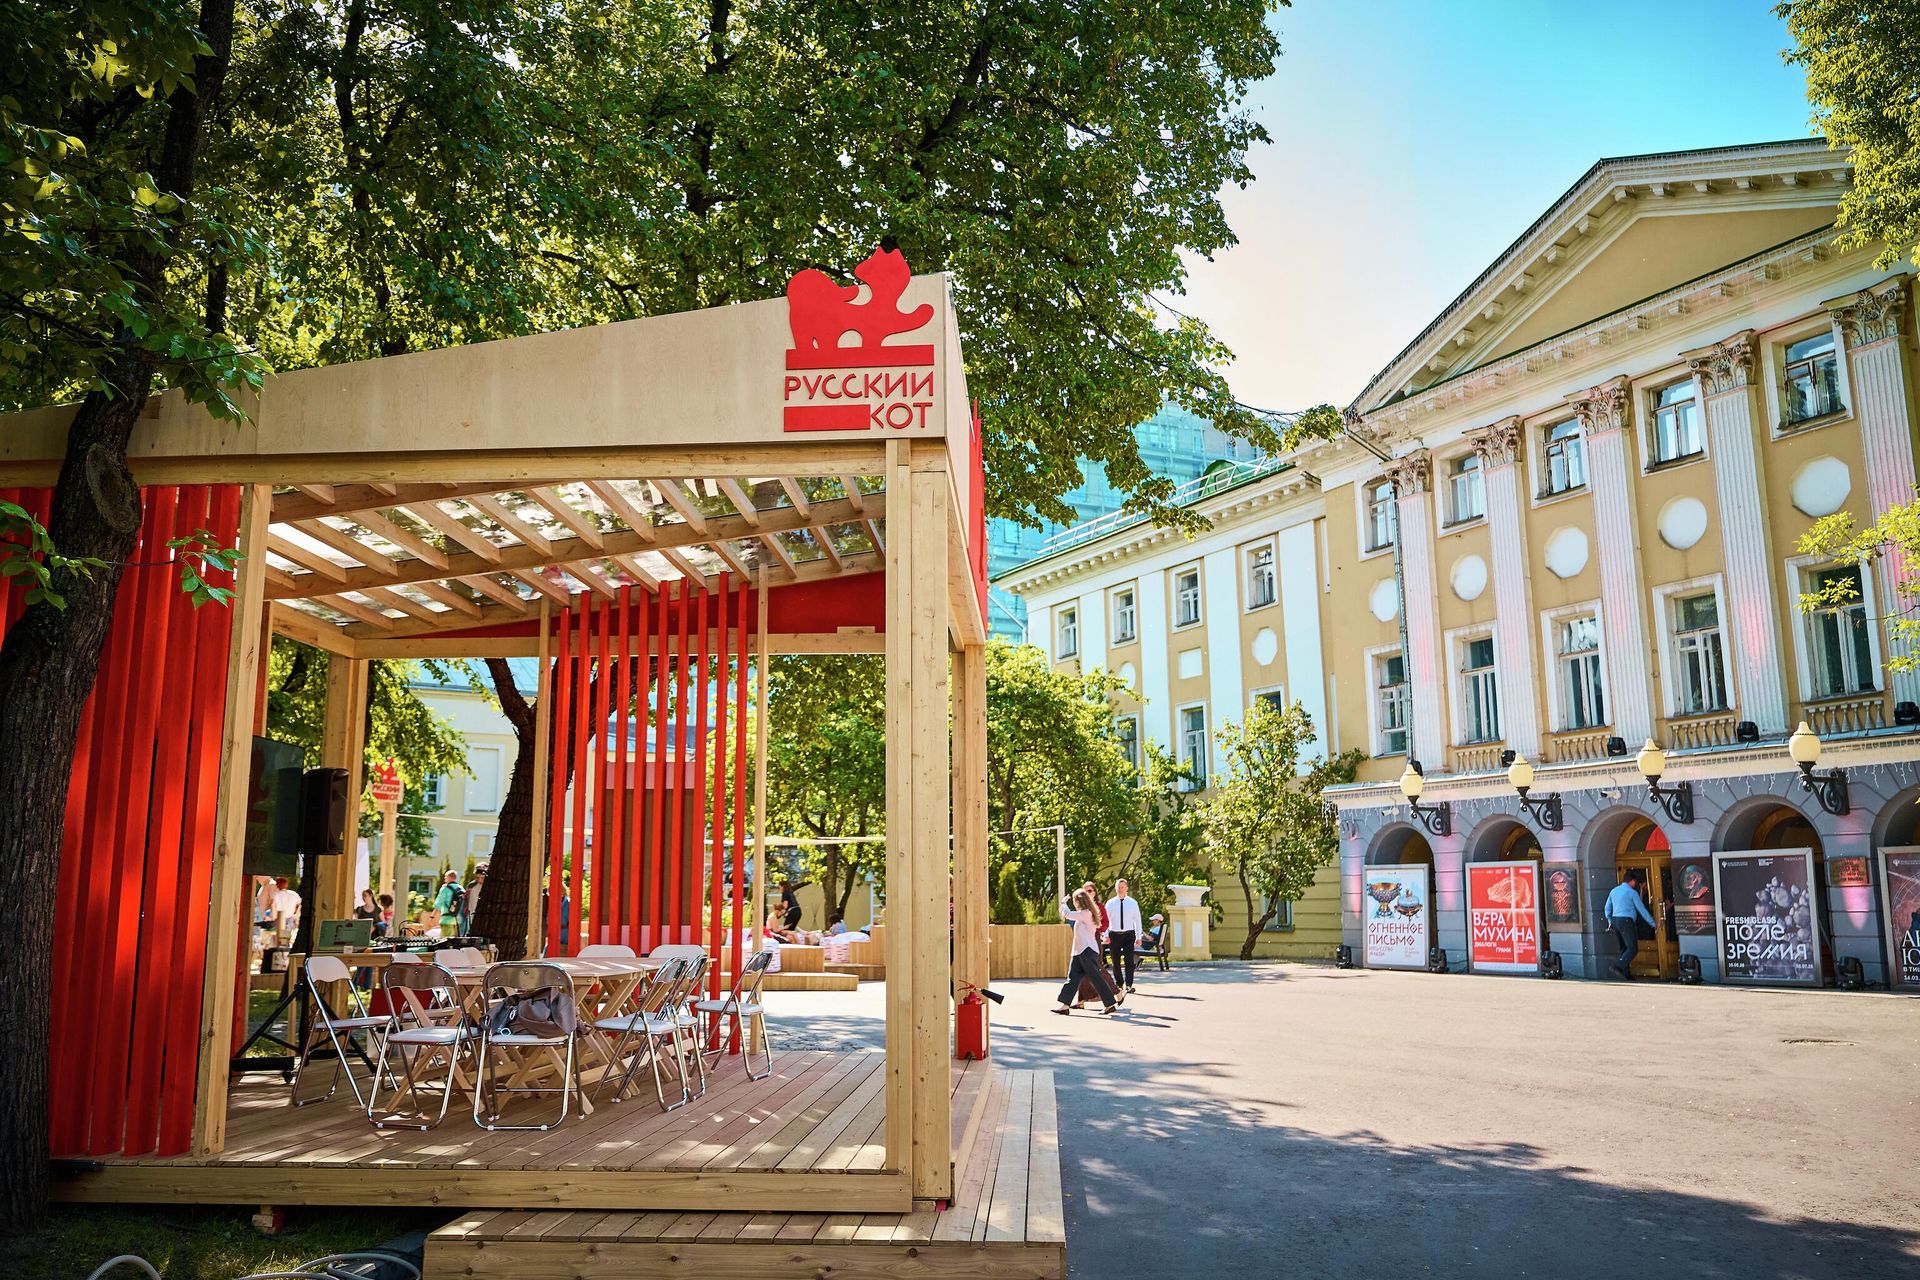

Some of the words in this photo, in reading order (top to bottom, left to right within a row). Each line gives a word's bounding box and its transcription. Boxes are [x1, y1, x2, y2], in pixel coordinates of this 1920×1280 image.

[870, 402, 934, 430] КОТ
[1473, 911, 1506, 926] ВЕРА
[1725, 917, 1750, 925] FRESH
[1751, 916, 1777, 924] GLASS
[1368, 922, 1423, 934] ОГНЕННОЕ
[1473, 926, 1535, 942] МУХИНА
[1368, 934, 1415, 946] ПИСЬМО
